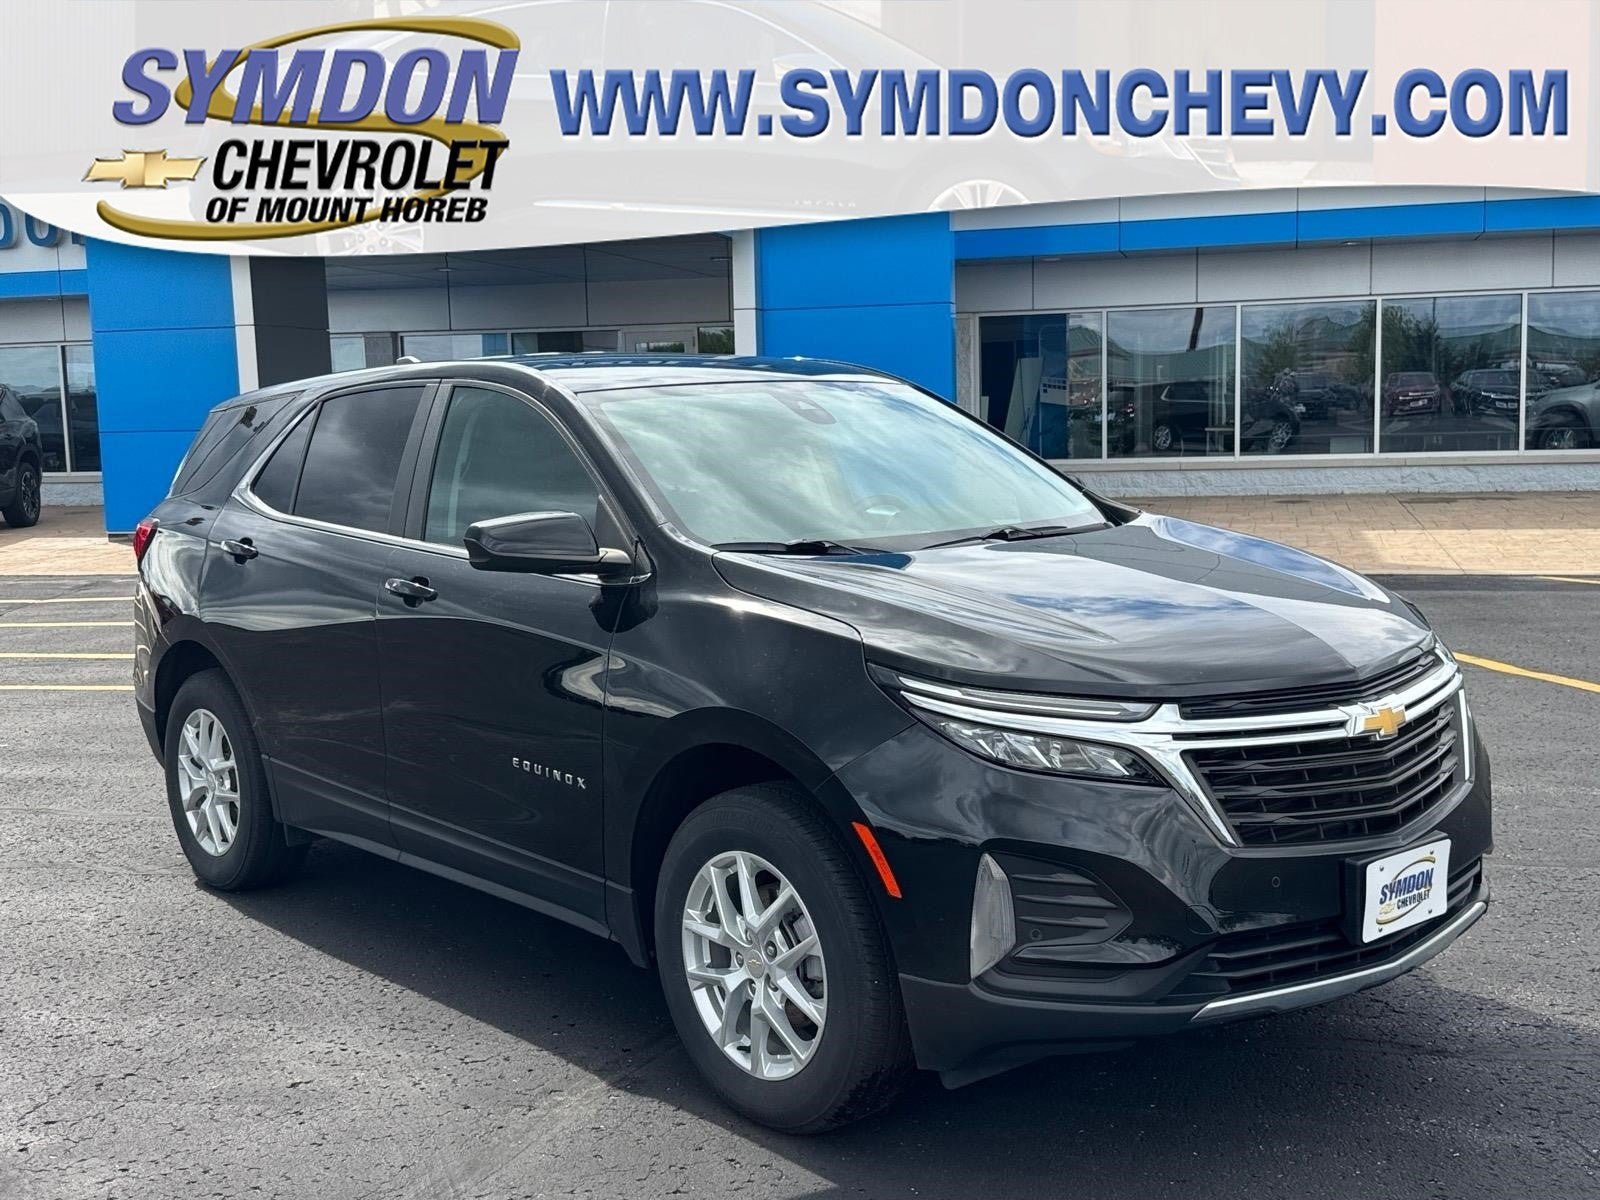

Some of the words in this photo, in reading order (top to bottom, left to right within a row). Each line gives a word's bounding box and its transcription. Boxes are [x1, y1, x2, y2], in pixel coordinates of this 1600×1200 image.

[512, 757, 586, 790] EQUINOX
[1379, 867, 1434, 905] SYMDON
[1397, 889, 1432, 910] CHEVROLET
